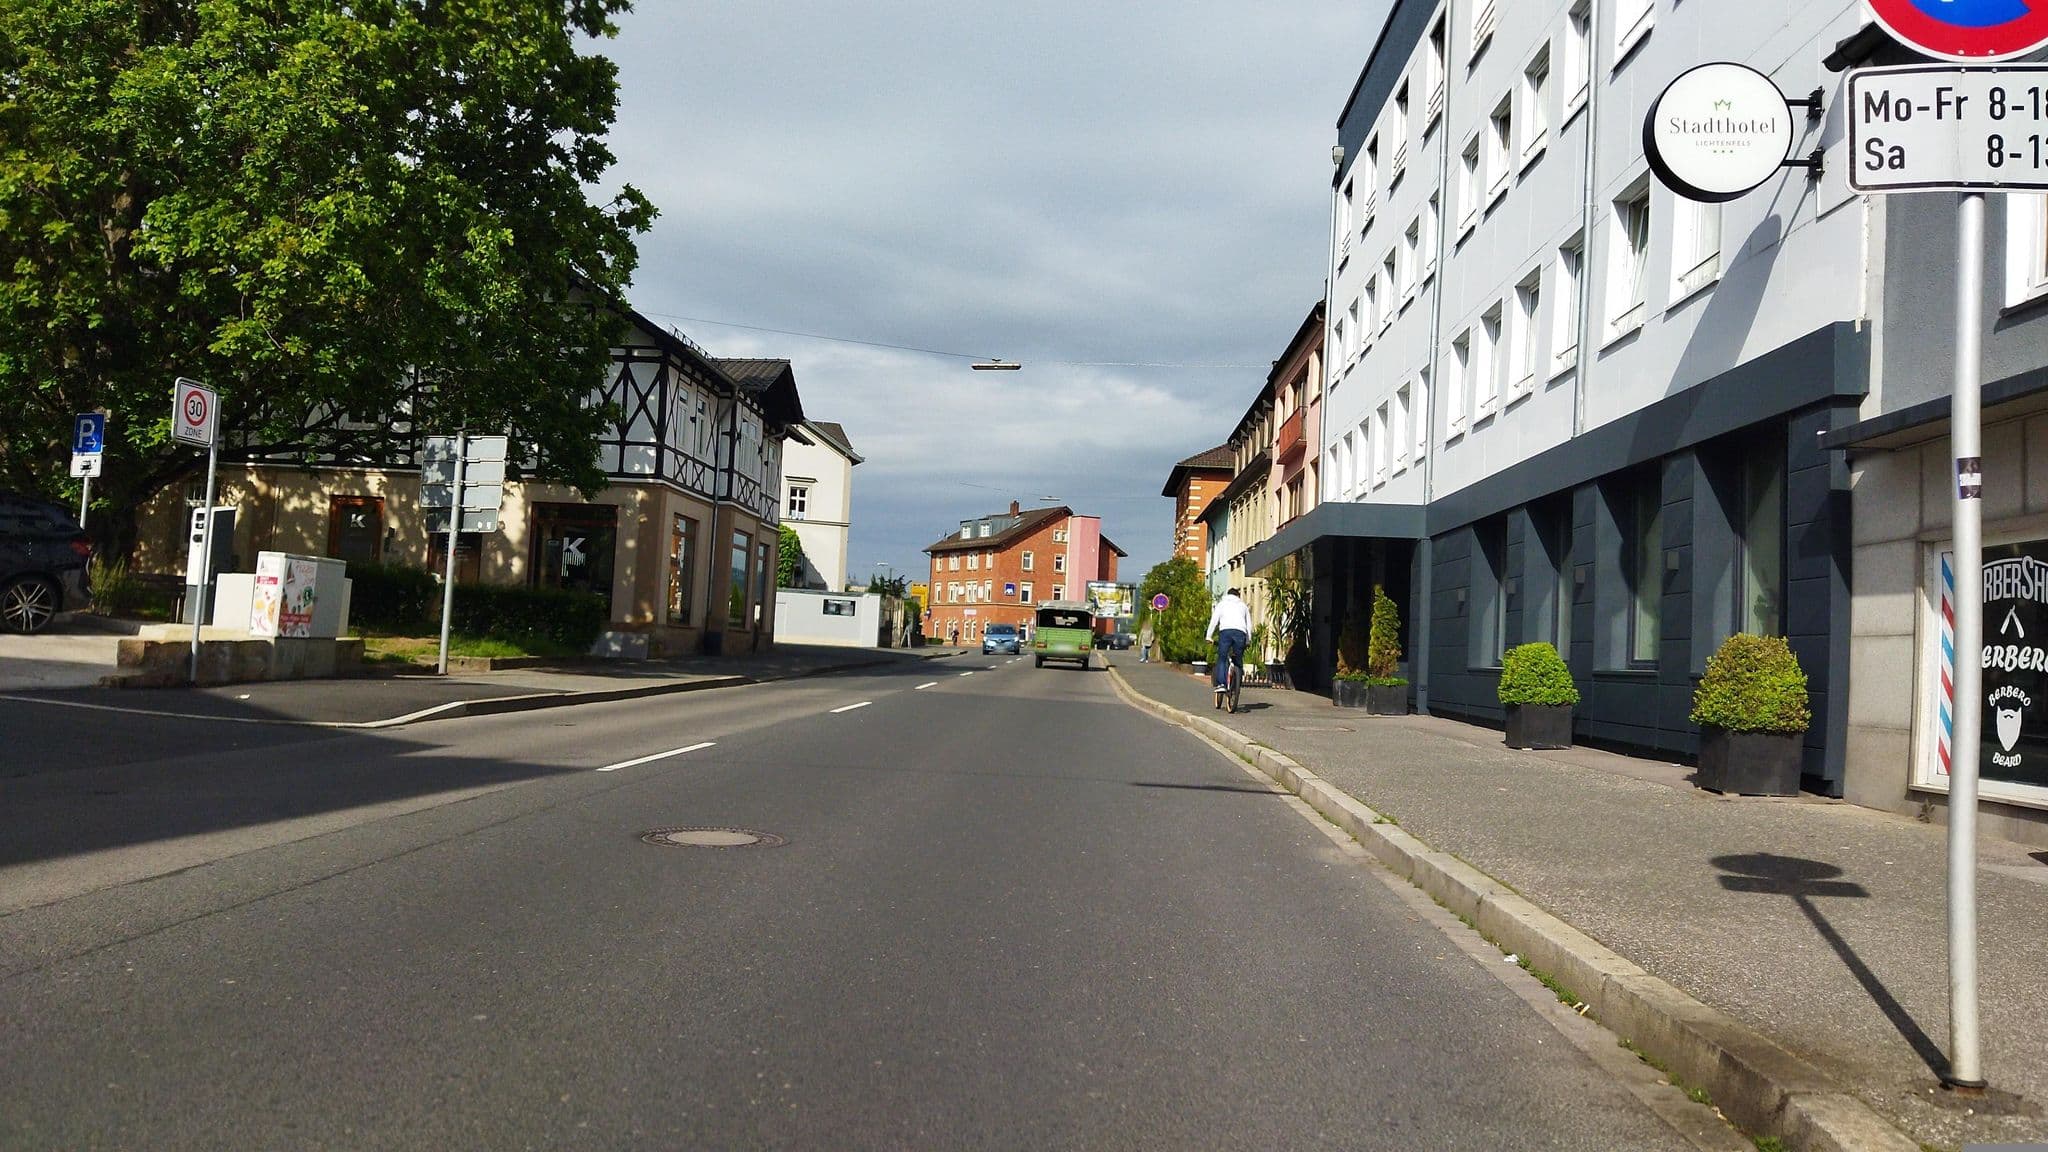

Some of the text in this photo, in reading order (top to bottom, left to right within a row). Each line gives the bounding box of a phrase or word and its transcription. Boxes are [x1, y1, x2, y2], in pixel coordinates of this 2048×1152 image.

[1864, 86, 2048, 124] Mo-Fr 8-1
[1670, 117, 1775, 134] Stadthotel
[1864, 133, 2048, 171] Sa 8-1
[188, 399, 203, 418] 30
[77, 418, 96, 449] P
[184, 426, 203, 439] ZONE
[1983, 555, 2048, 604] RBERSH
